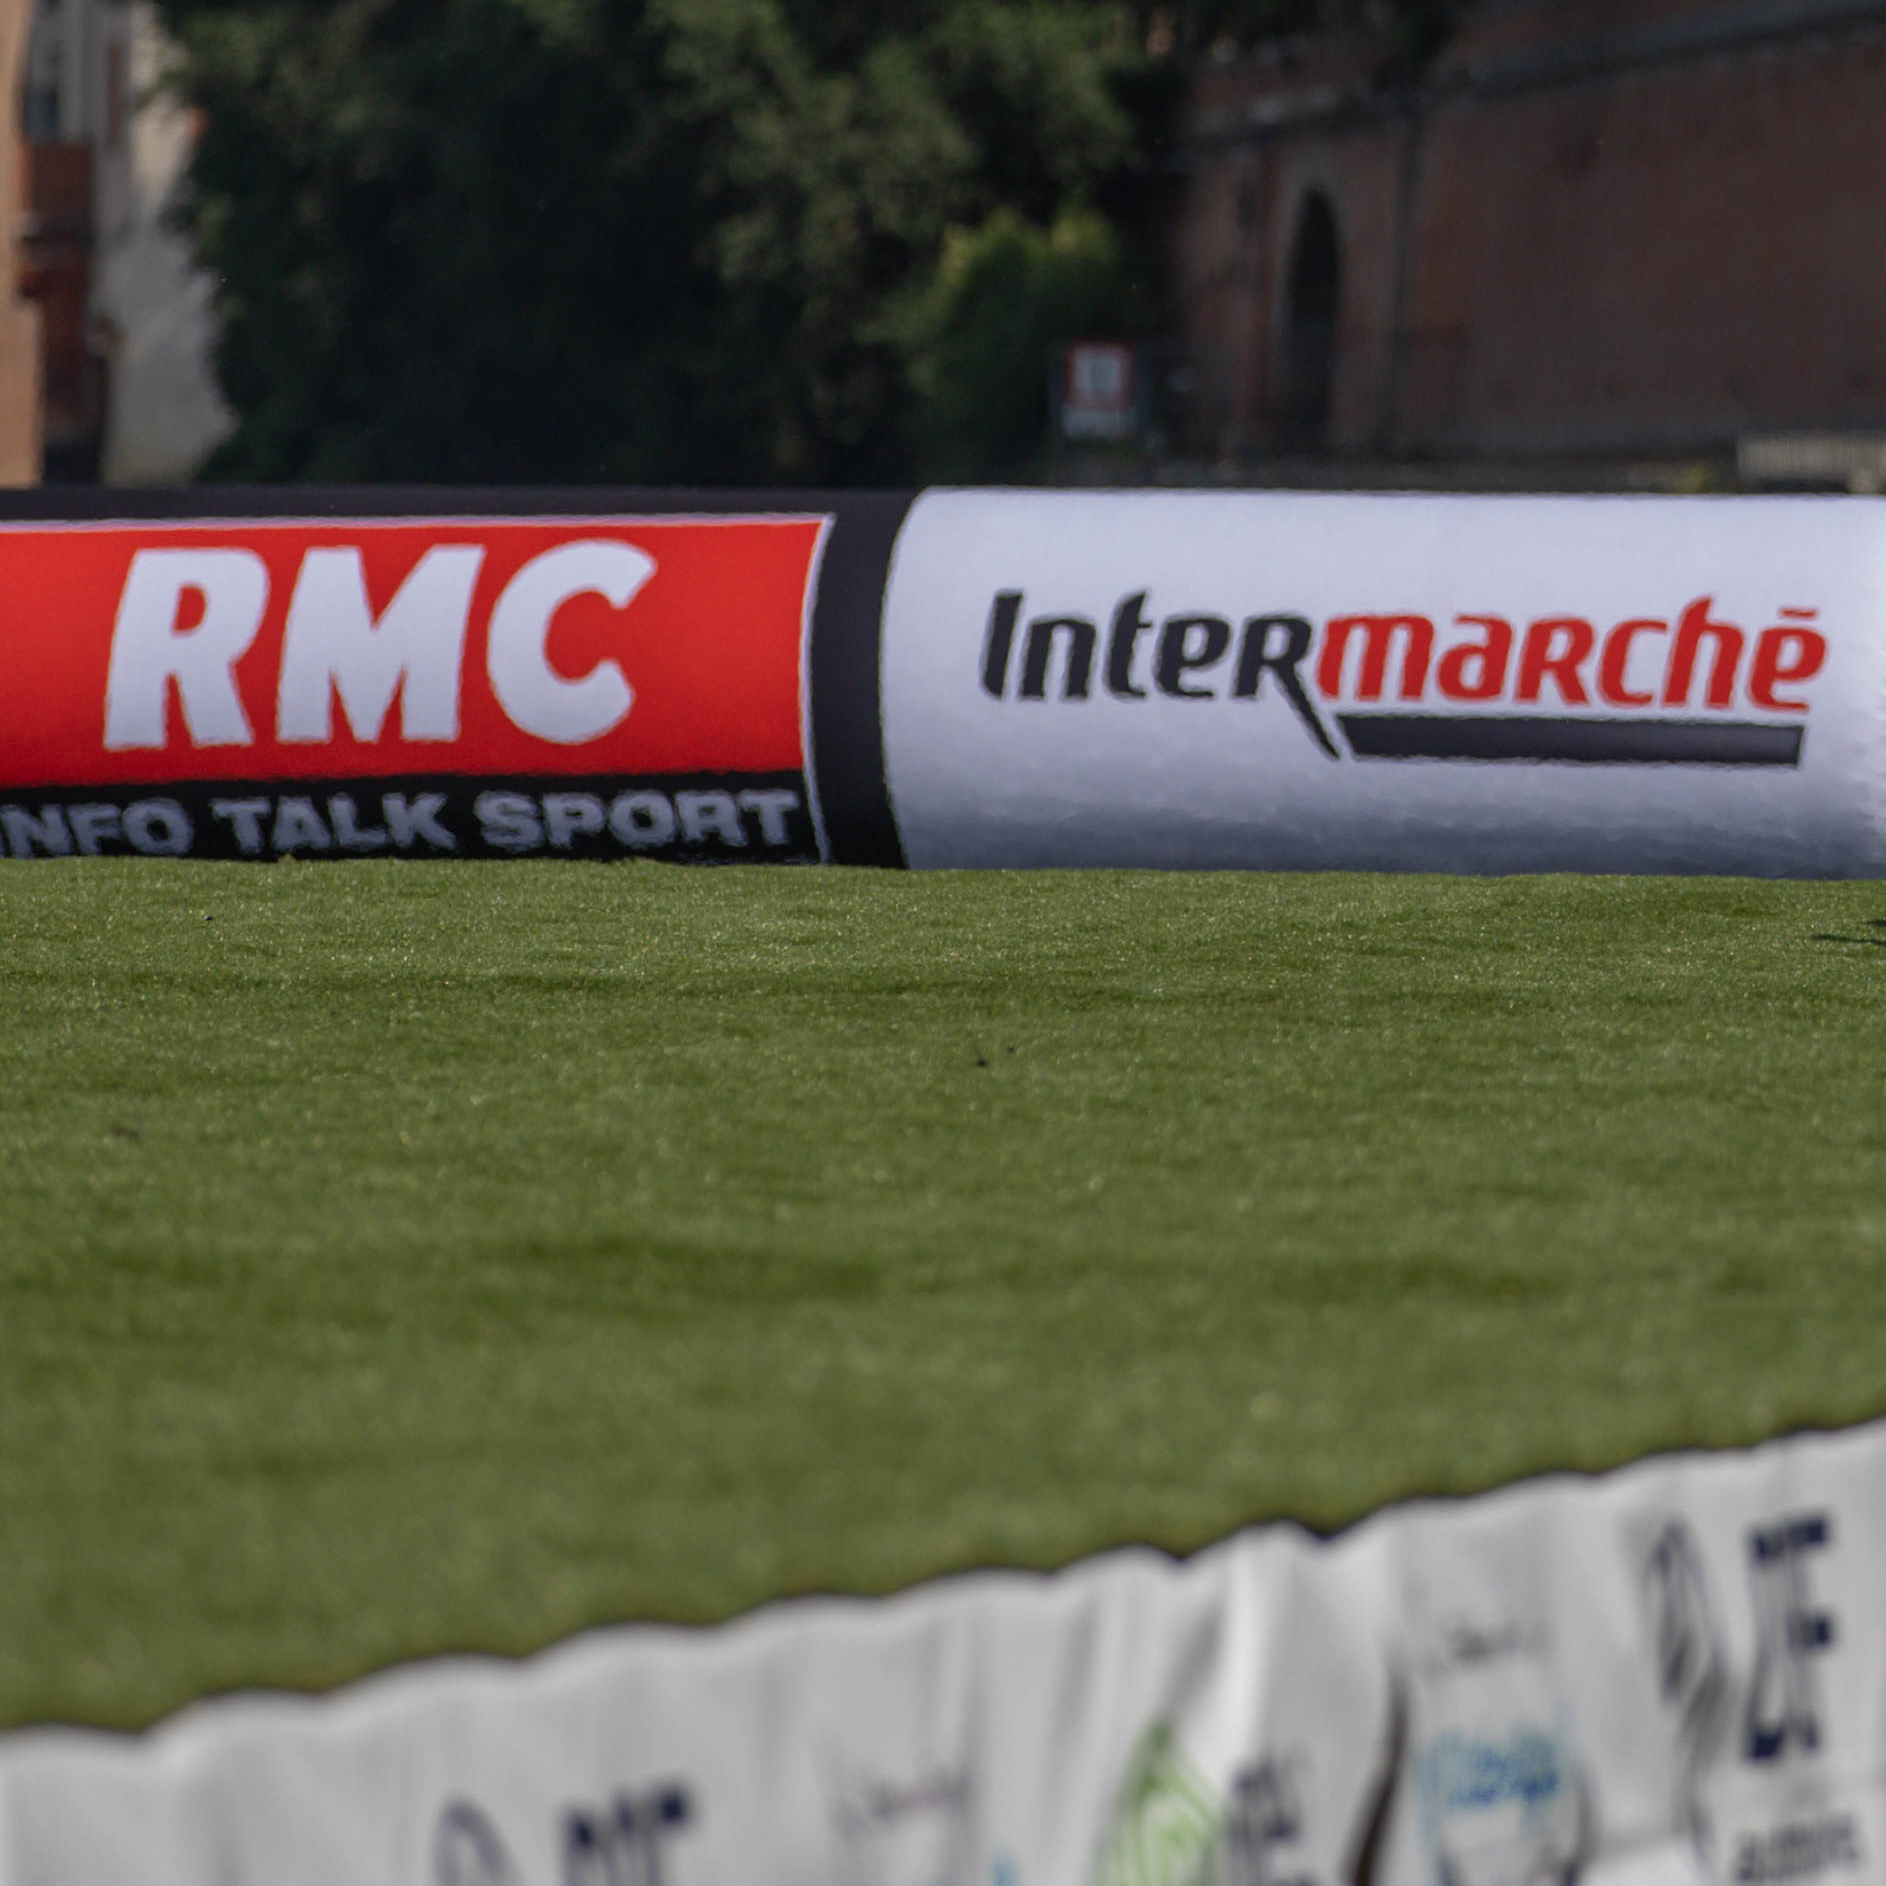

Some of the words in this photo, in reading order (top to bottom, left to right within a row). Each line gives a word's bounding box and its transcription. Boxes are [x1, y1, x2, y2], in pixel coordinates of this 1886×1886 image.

[103, 538, 658, 752] RMC
[0, 799, 195, 860] NFO
[211, 792, 458, 853] TALK
[474, 788, 800, 850] SPORT
